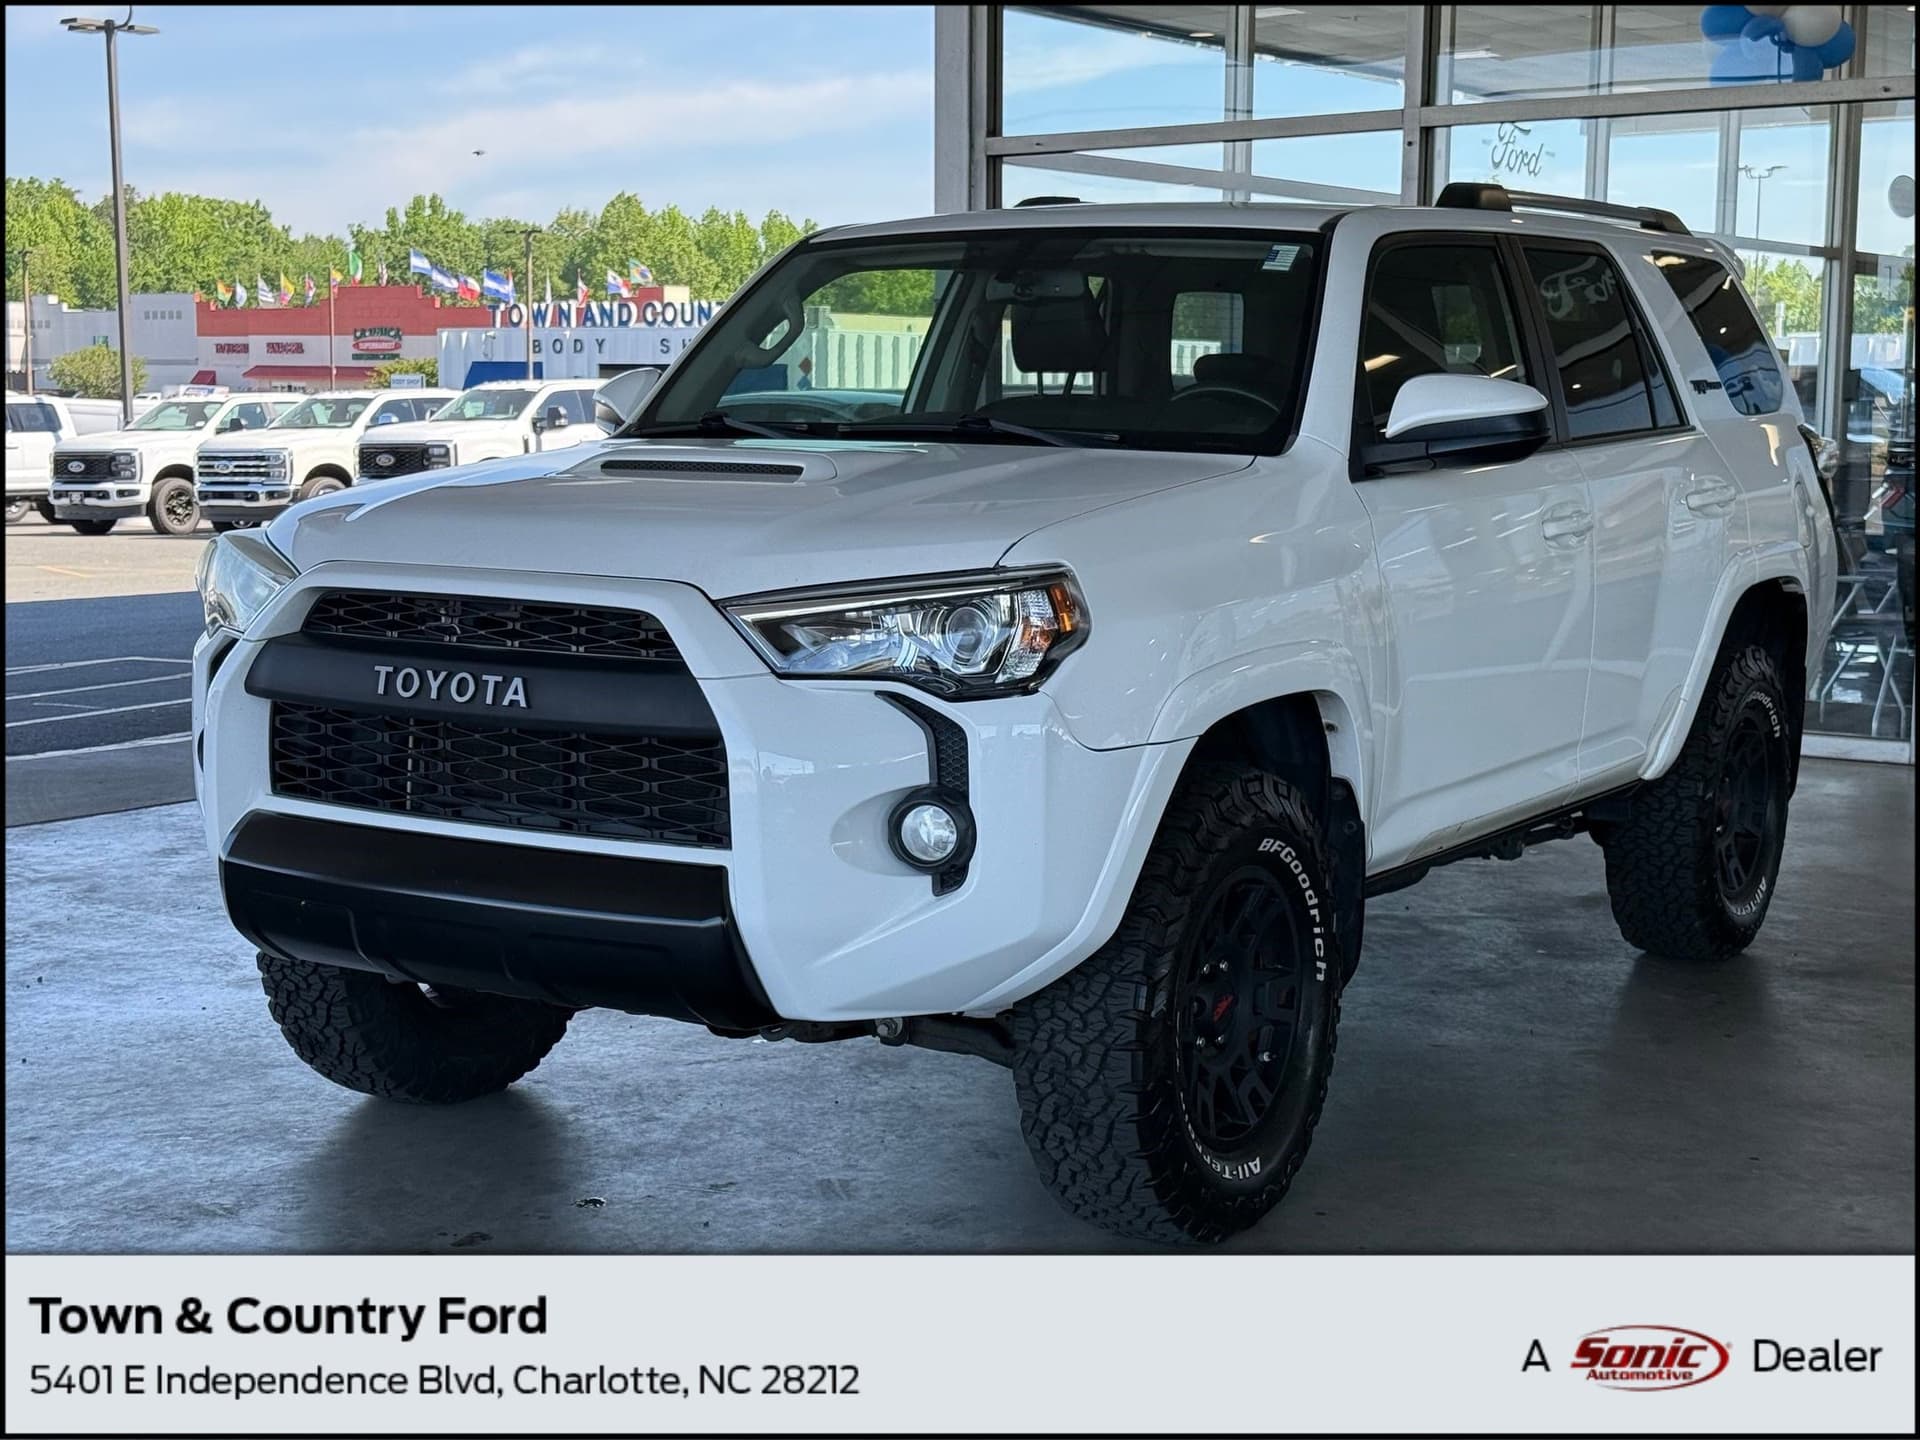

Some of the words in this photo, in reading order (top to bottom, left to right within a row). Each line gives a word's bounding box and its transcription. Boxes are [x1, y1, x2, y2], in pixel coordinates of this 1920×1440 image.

[1491, 121, 1544, 178] Ford
[488, 302, 577, 328] TOWN
[583, 302, 634, 328] AND
[642, 302, 727, 328] COUN
[532, 338, 606, 354] BODY
[374, 665, 527, 708] TOYOTA
[1257, 837, 1327, 982] BFGoodrich
